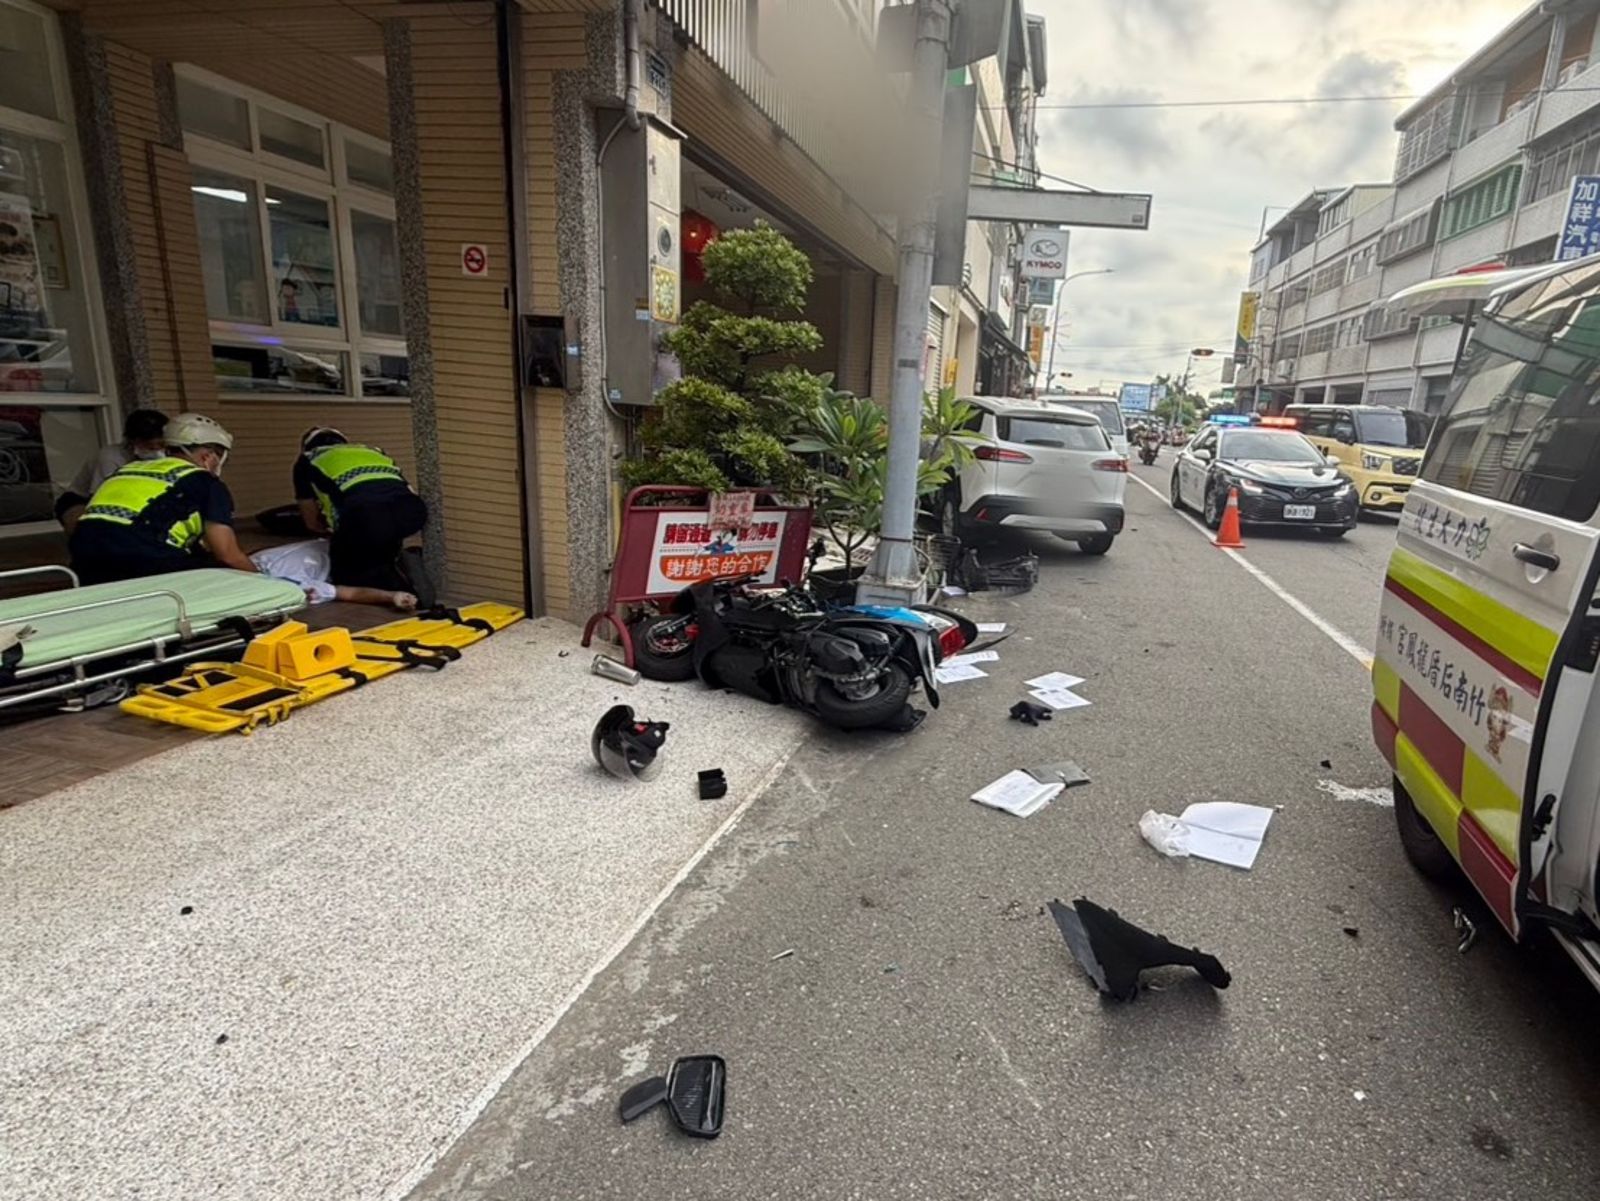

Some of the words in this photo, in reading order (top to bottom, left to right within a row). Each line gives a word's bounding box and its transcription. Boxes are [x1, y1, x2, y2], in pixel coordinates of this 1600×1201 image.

[1026, 260, 1062, 270] KYMCO
[666, 555, 768, 577] 謝謝您的合作
